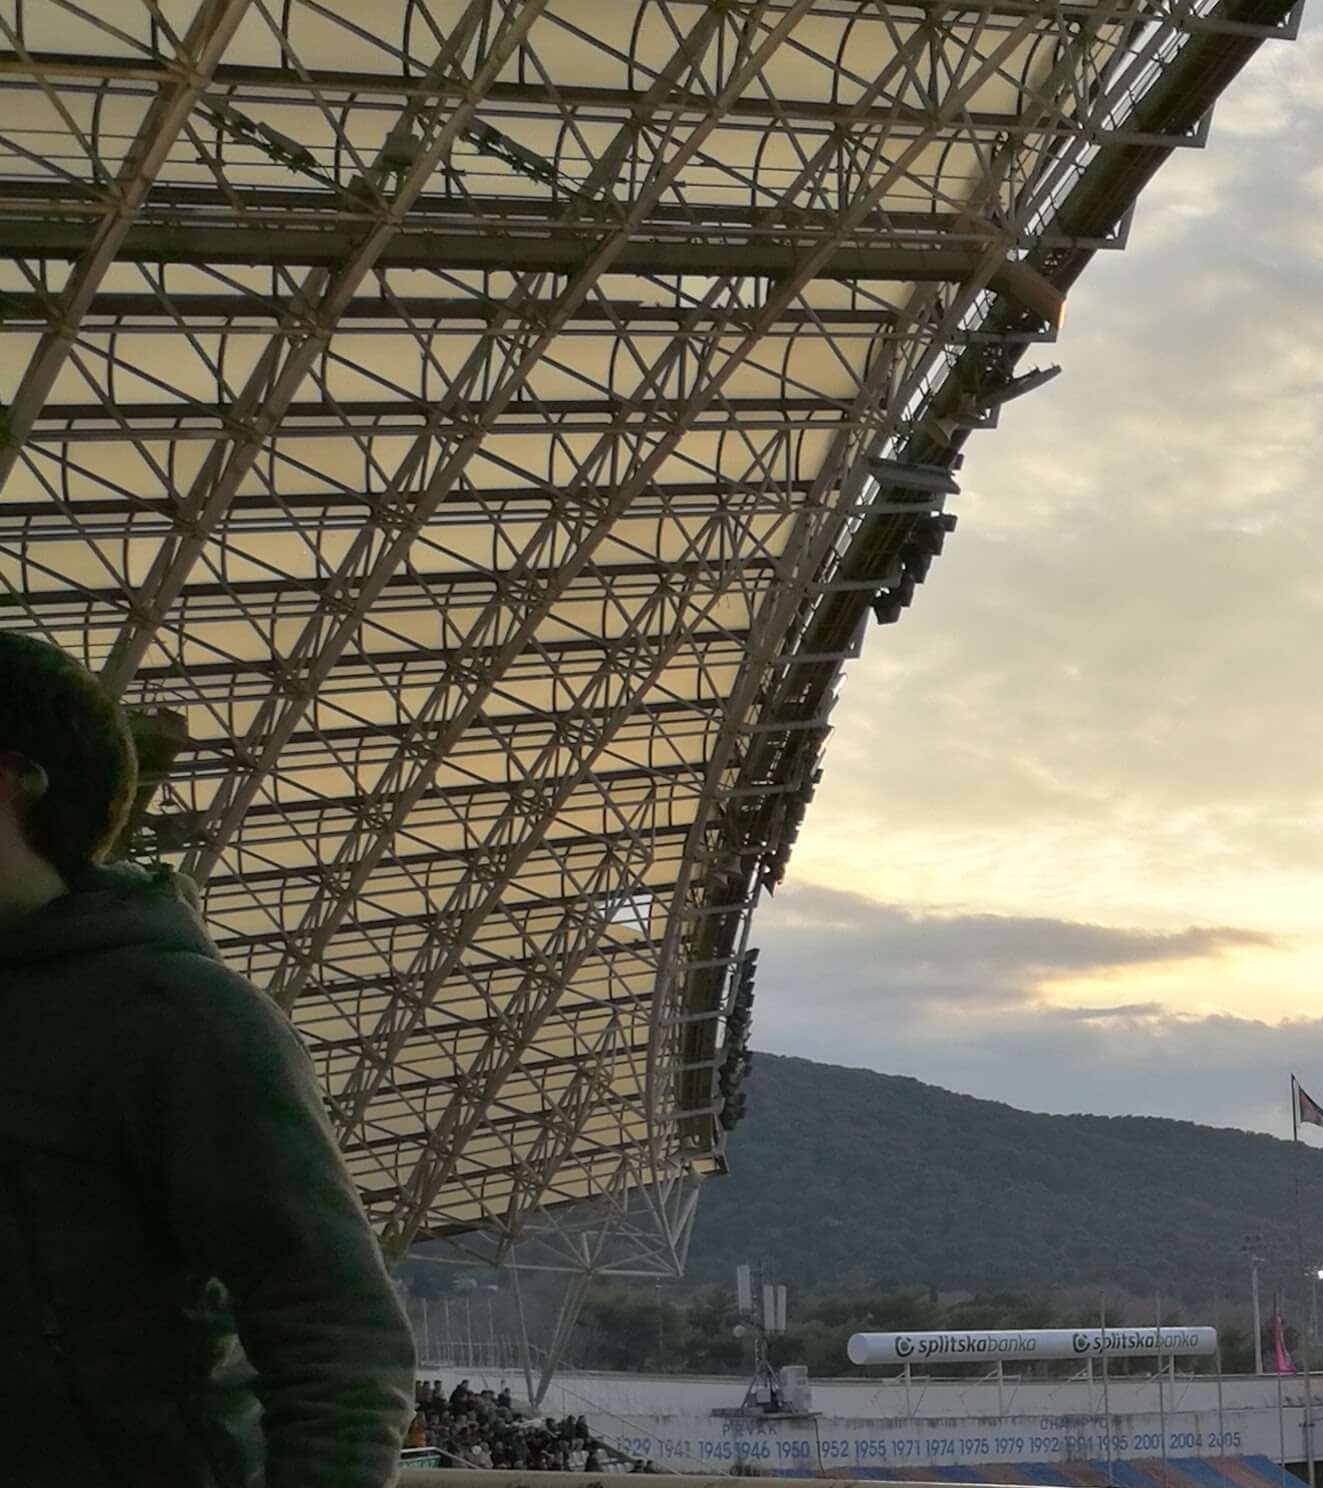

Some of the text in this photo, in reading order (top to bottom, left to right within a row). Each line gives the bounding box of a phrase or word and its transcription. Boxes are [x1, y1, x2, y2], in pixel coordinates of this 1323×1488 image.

[919, 1337, 1036, 1358] splitskabanka
[699, 1440, 732, 1460] 1945
[776, 1440, 809, 1459] 1950
[855, 1439, 887, 1458] 1955
[892, 1439, 921, 1458] 1971
[926, 1438, 955, 1457] 1974
[959, 1438, 990, 1456] 1975
[994, 1437, 1024, 1455] 1979
[1169, 1432, 1201, 1450] 2004
